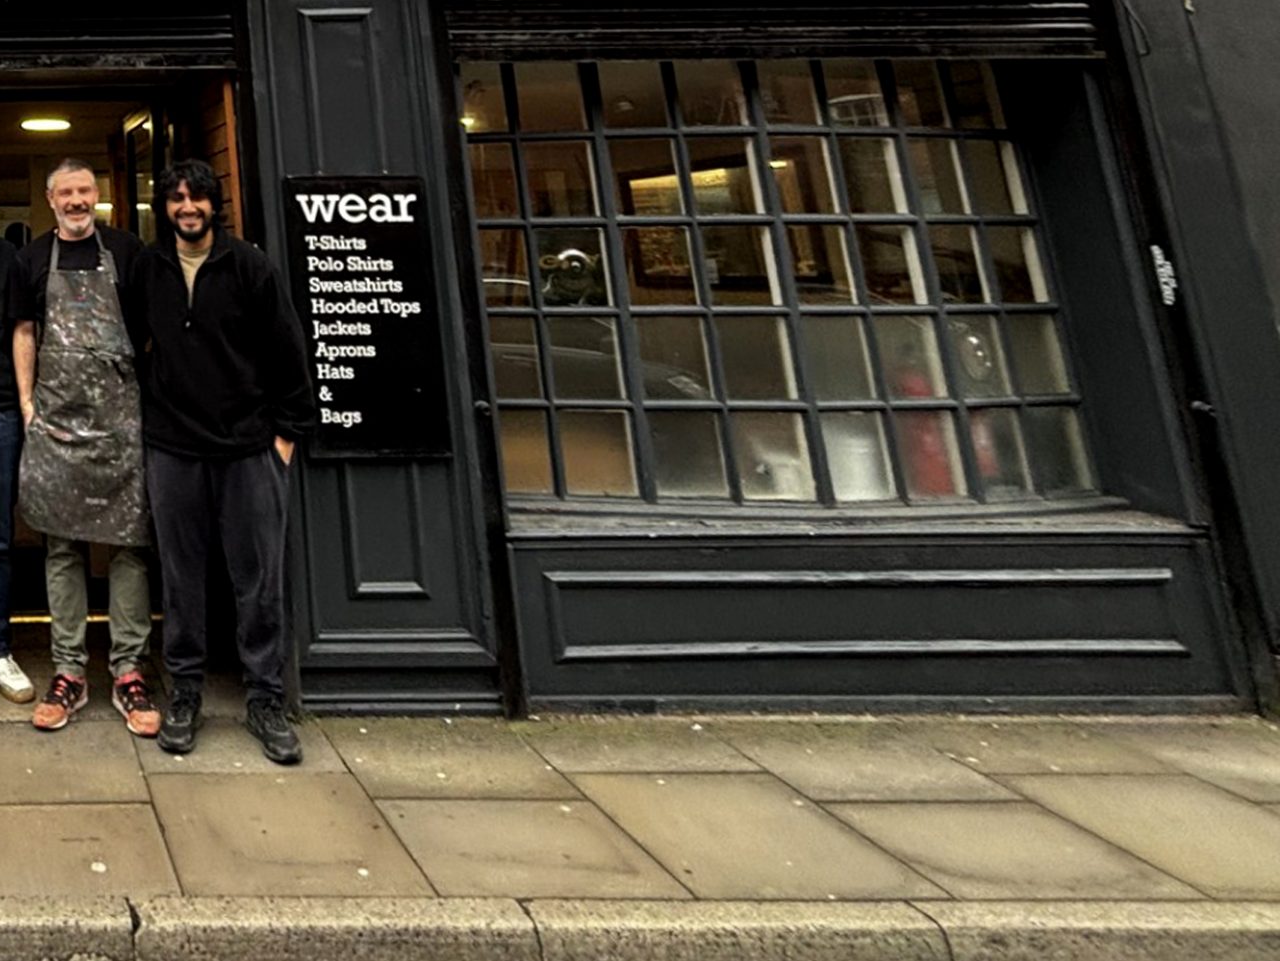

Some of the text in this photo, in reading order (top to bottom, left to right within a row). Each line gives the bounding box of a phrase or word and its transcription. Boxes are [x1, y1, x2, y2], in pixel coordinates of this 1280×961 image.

[296, 194, 416, 223] wear
[305, 236, 366, 250] T-Shirts
[307, 256, 393, 271] Polo Shirts
[309, 277, 403, 292] Sweatshirts
[311, 298, 421, 317] Hooded Tops
[313, 320, 371, 339] Jackets
[315, 342, 376, 361] Aprons
[317, 364, 354, 379] Hats
[319, 386, 332, 401] &
[321, 408, 362, 427] Bags
